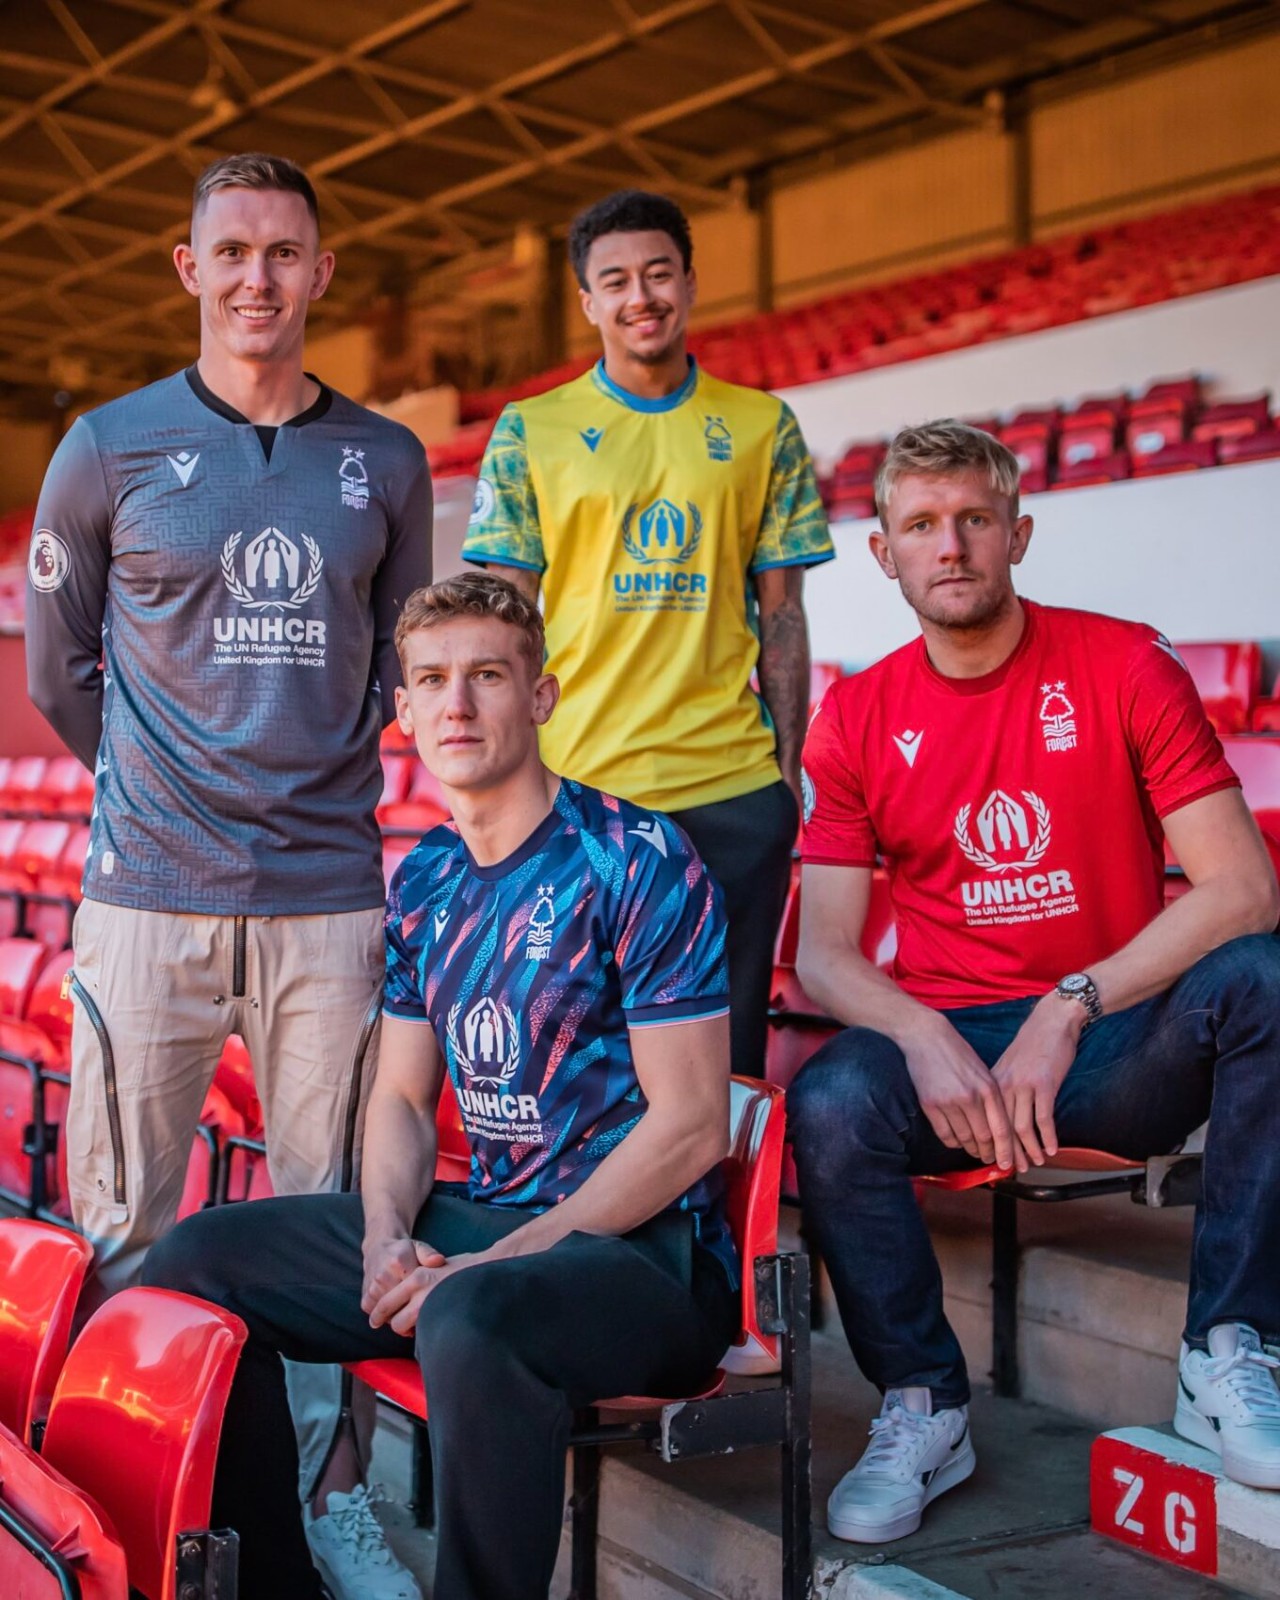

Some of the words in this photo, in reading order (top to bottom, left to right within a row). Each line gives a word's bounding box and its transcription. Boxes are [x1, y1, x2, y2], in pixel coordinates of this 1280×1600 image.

[614, 572, 707, 594] UNHCR
[213, 617, 326, 644] UNHCR
[214, 643, 232, 653] The
[233, 643, 249, 653] UN
[251, 643, 291, 655] Refugee
[293, 644, 326, 657] Agency
[213, 655, 241, 665] United
[243, 655, 281, 666] Kingdom
[283, 656, 295, 665] for
[295, 657, 326, 668] UNHCR
[961, 869, 1074, 907] UNHCR
[964, 907, 982, 917] The
[982, 905, 998, 916] UN
[999, 902, 1038, 914] Refugee
[1040, 894, 1076, 908] Agency
[966, 918, 993, 926] United
[994, 913, 1031, 925] Kingdom
[1031, 912, 1044, 921] for
[1045, 904, 1079, 918] UNHCR
[456, 1088, 541, 1120] UNHCR
[483, 1117, 510, 1131] Refugee
[511, 1121, 542, 1133] Agency
[515, 1133, 544, 1143] UNHCR
